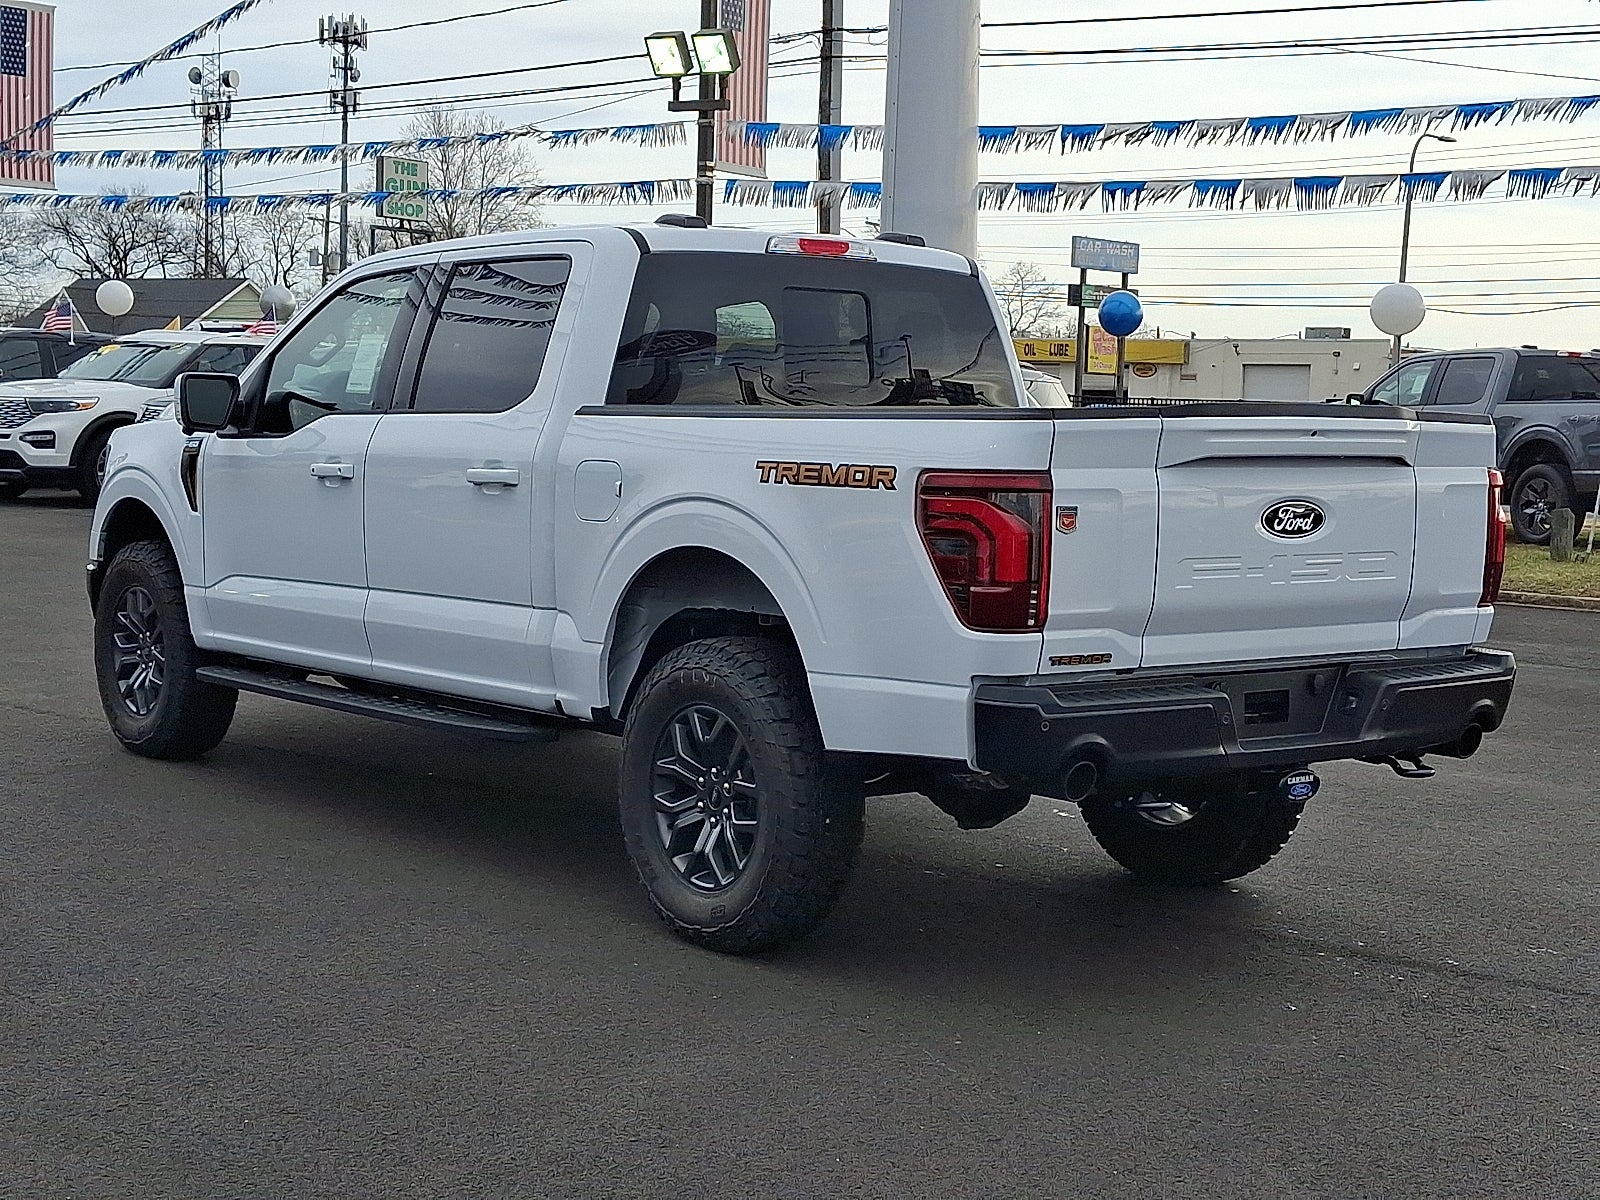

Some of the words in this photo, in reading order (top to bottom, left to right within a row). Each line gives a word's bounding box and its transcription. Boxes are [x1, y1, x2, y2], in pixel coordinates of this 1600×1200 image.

[393, 160, 418, 176] THE
[387, 201, 424, 218] SHOP
[1080, 239, 1102, 253] CAR
[1106, 242, 1135, 257] WASH
[1023, 342, 1036, 357] OIL
[1049, 342, 1070, 357] LUBE
[756, 460, 898, 491] TREMOR
[1273, 505, 1315, 531] Ford
[1175, 551, 1398, 588] F-150
[1049, 653, 1113, 666] TREMOR
